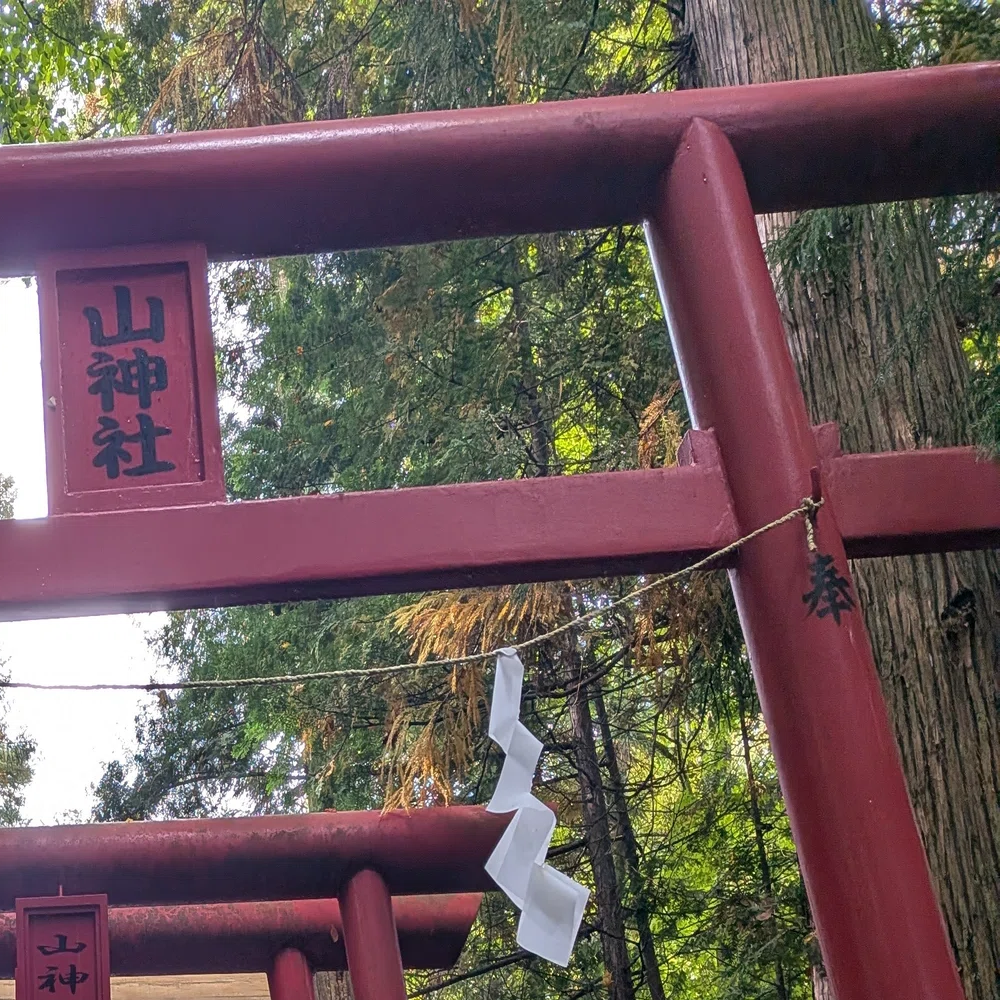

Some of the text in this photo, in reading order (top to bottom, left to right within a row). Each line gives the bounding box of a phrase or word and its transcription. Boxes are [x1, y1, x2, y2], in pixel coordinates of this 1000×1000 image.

[83, 285, 176, 479] 山神社
[802, 553, 856, 627] 奉
